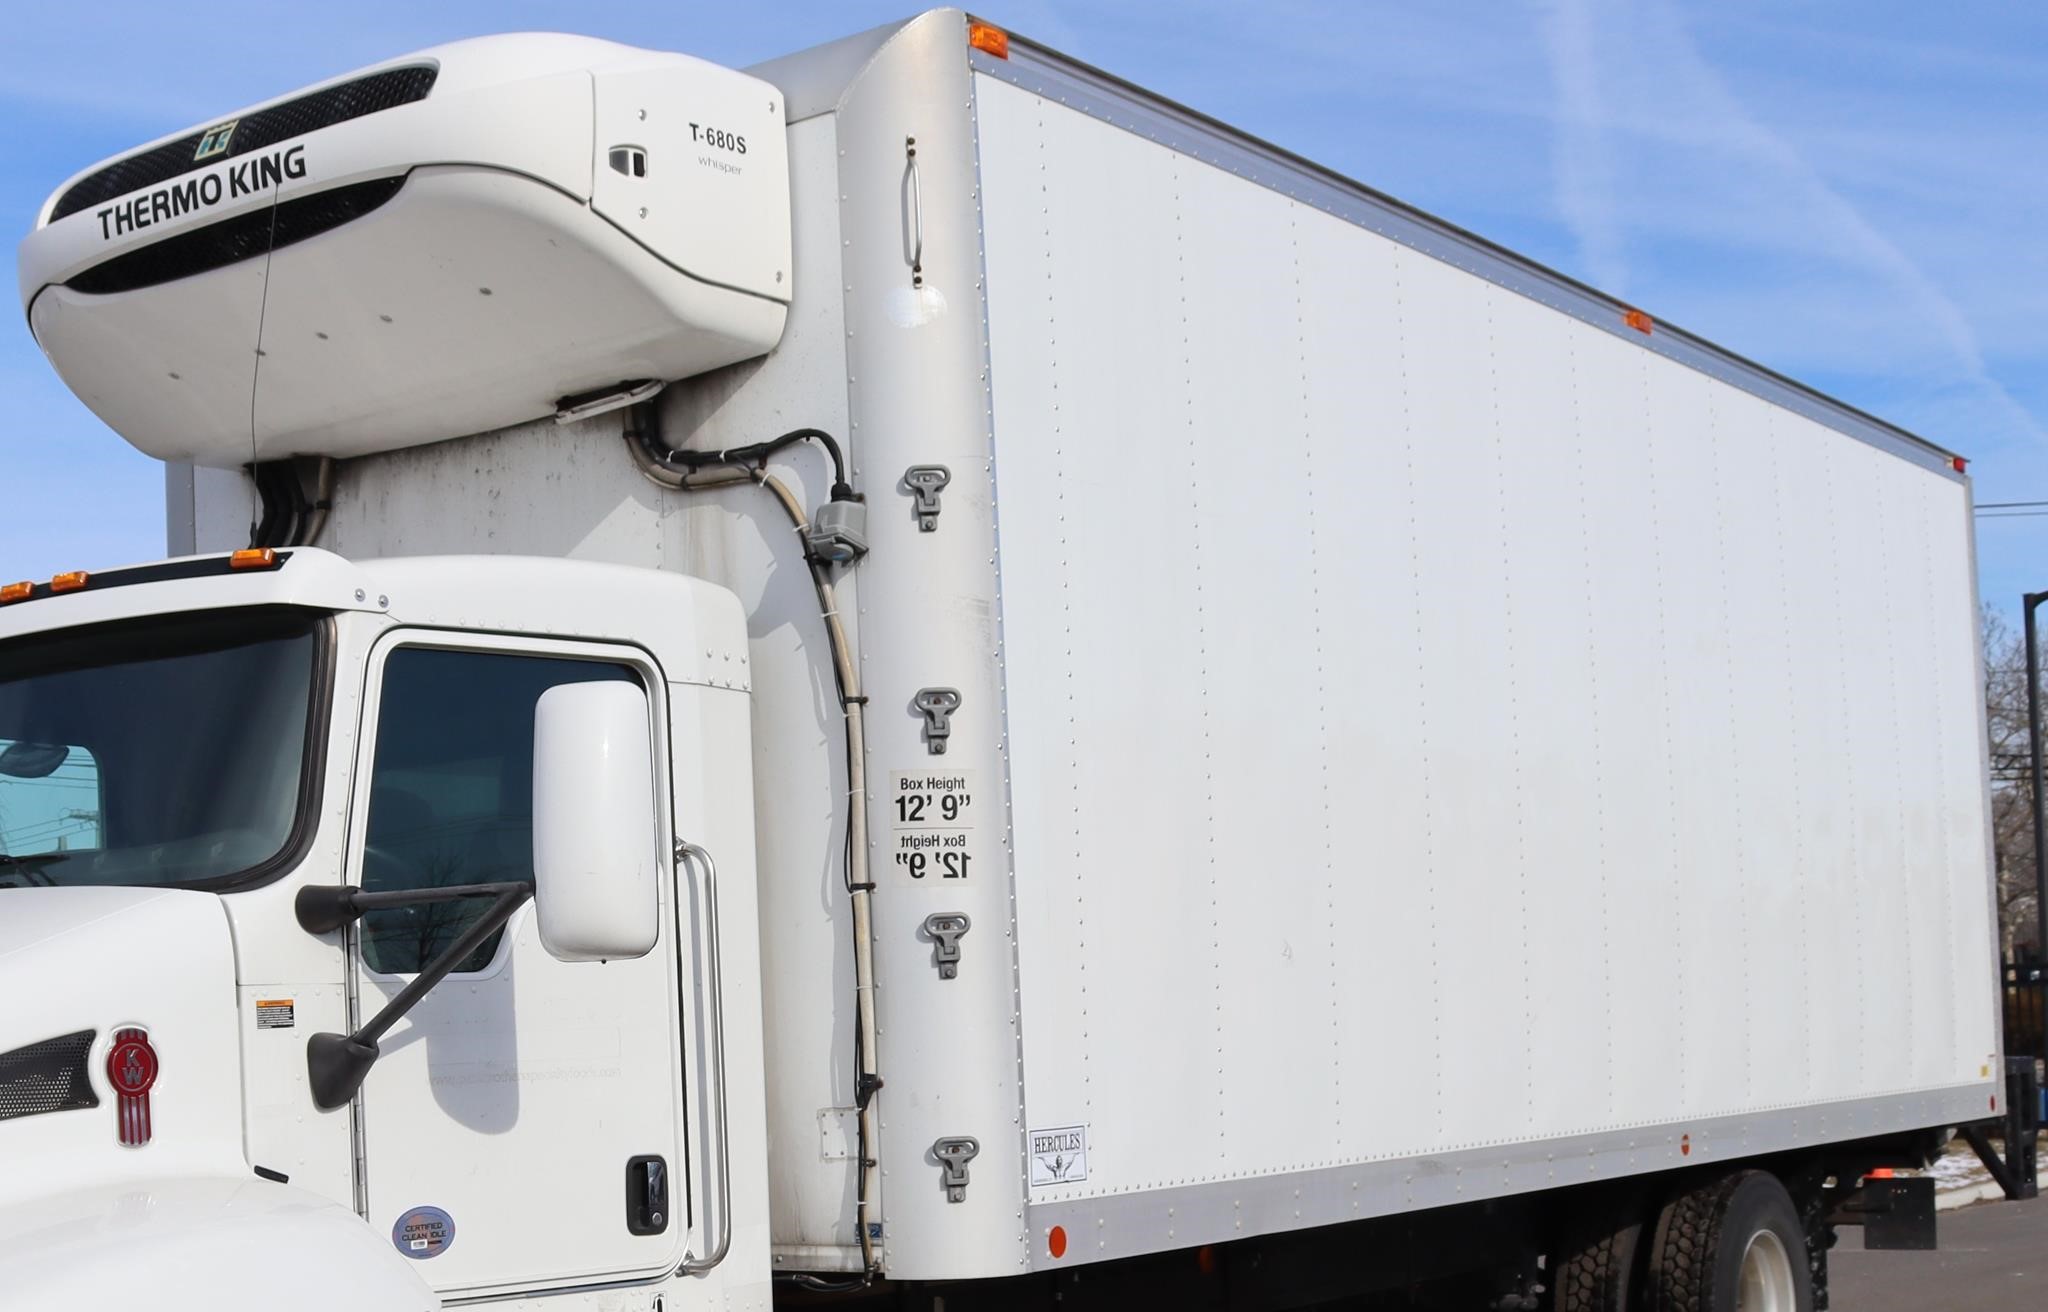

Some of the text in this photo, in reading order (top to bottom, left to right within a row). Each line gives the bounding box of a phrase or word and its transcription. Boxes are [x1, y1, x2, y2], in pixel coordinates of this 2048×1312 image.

[688, 122, 747, 154] T-680S
[698, 156, 742, 175] whisper
[97, 144, 307, 240] THERMO KING
[900, 777, 966, 792] Box Height
[895, 794, 971, 822] 12' 9"
[1034, 1133, 1081, 1154] HERCULES
[404, 1222, 443, 1233] CERTIFIED
